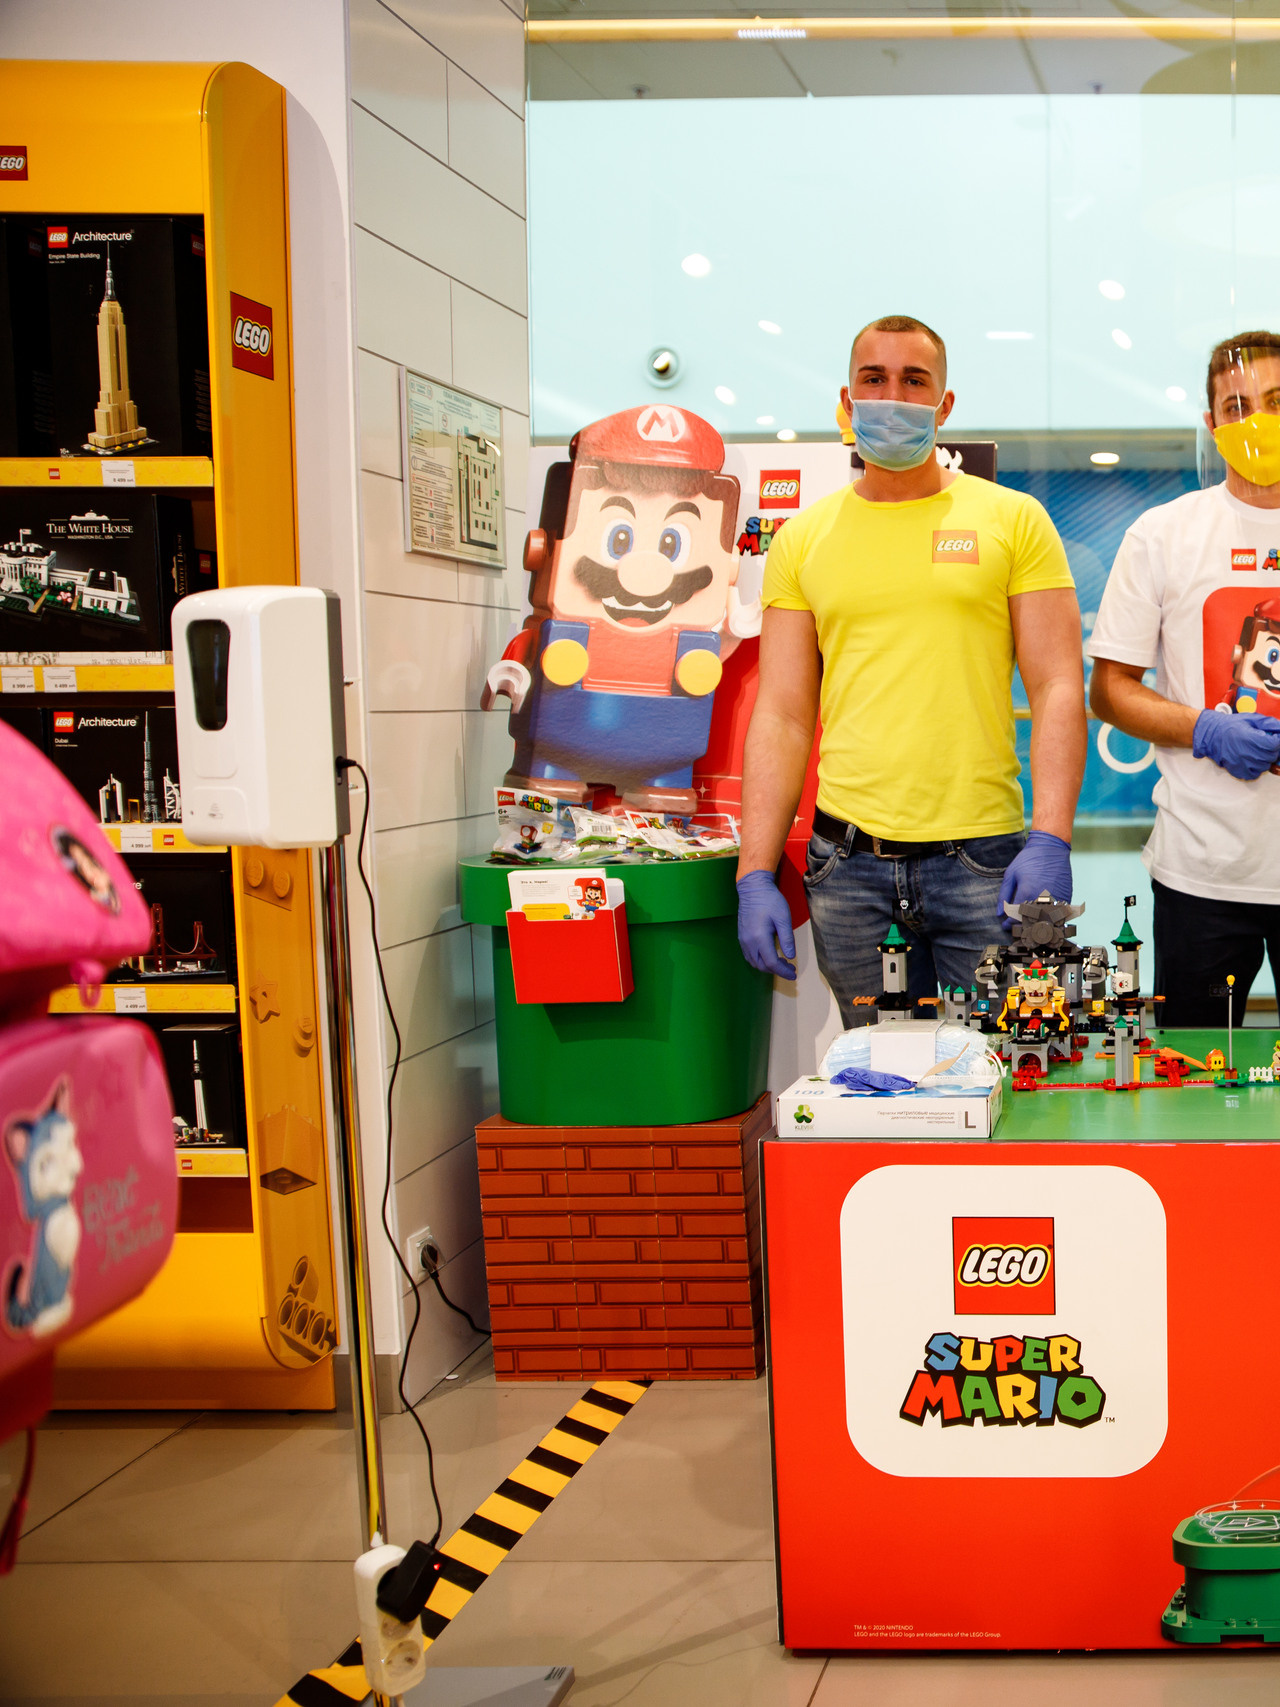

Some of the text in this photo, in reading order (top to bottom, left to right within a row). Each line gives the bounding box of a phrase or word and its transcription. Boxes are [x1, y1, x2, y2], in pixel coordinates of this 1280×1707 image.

[49, 231, 132, 244] LEGO Architecture
[80, 252, 101, 260] Building
[234, 316, 271, 355] LEGO
[761, 480, 799, 498] LEGO
[46, 523, 134, 534] THE WHITE HOUSE
[745, 516, 792, 535] SUP
[934, 536, 978, 555] LEGO
[1232, 554, 1256, 565] LEGO
[55, 717, 137, 729] LEGO Architecture
[519, 800, 554, 813] MARIO
[522, 794, 550, 805] SUPER
[965, 1111, 977, 1129] L
[958, 1244, 1051, 1287] LEGO
[924, 1332, 1084, 1375] SUPER
[899, 1369, 1106, 1429] MARIO
